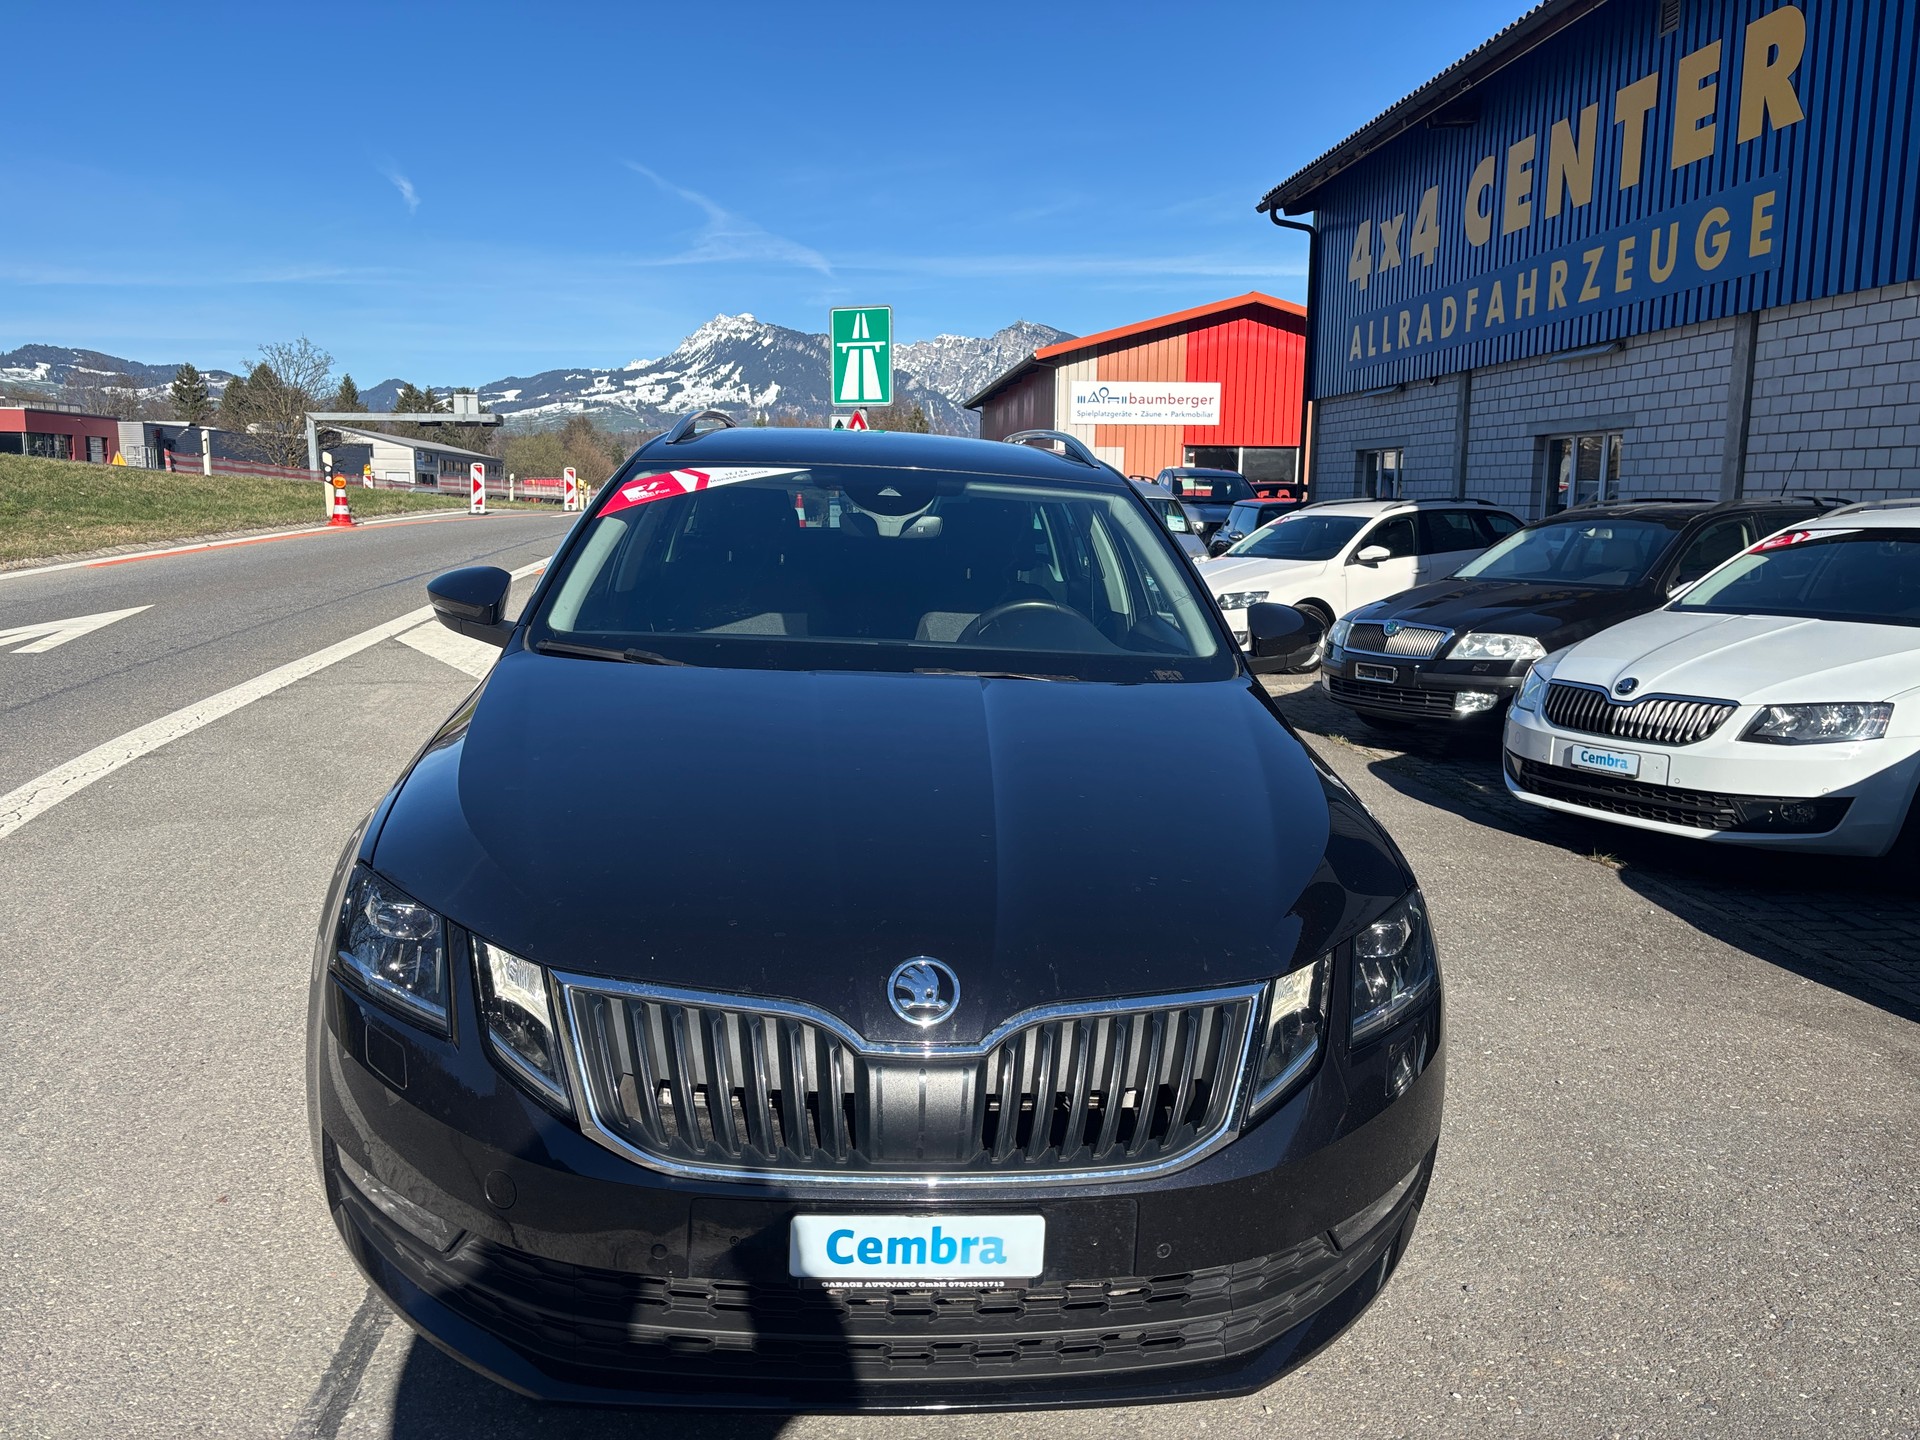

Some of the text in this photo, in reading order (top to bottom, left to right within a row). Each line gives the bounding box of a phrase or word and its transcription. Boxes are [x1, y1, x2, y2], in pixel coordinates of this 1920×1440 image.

[1348, 5, 1807, 291] 4x4 CENTER
[1348, 190, 1776, 362] ALLRADFAHRZEUGE
[1076, 410, 1214, 419] Spielplatzgeräte Zäune Parkmobiliar
[1129, 392, 1214, 408] baumberger
[1581, 750, 1628, 769] Cembra
[826, 1226, 1007, 1265] Cembra
